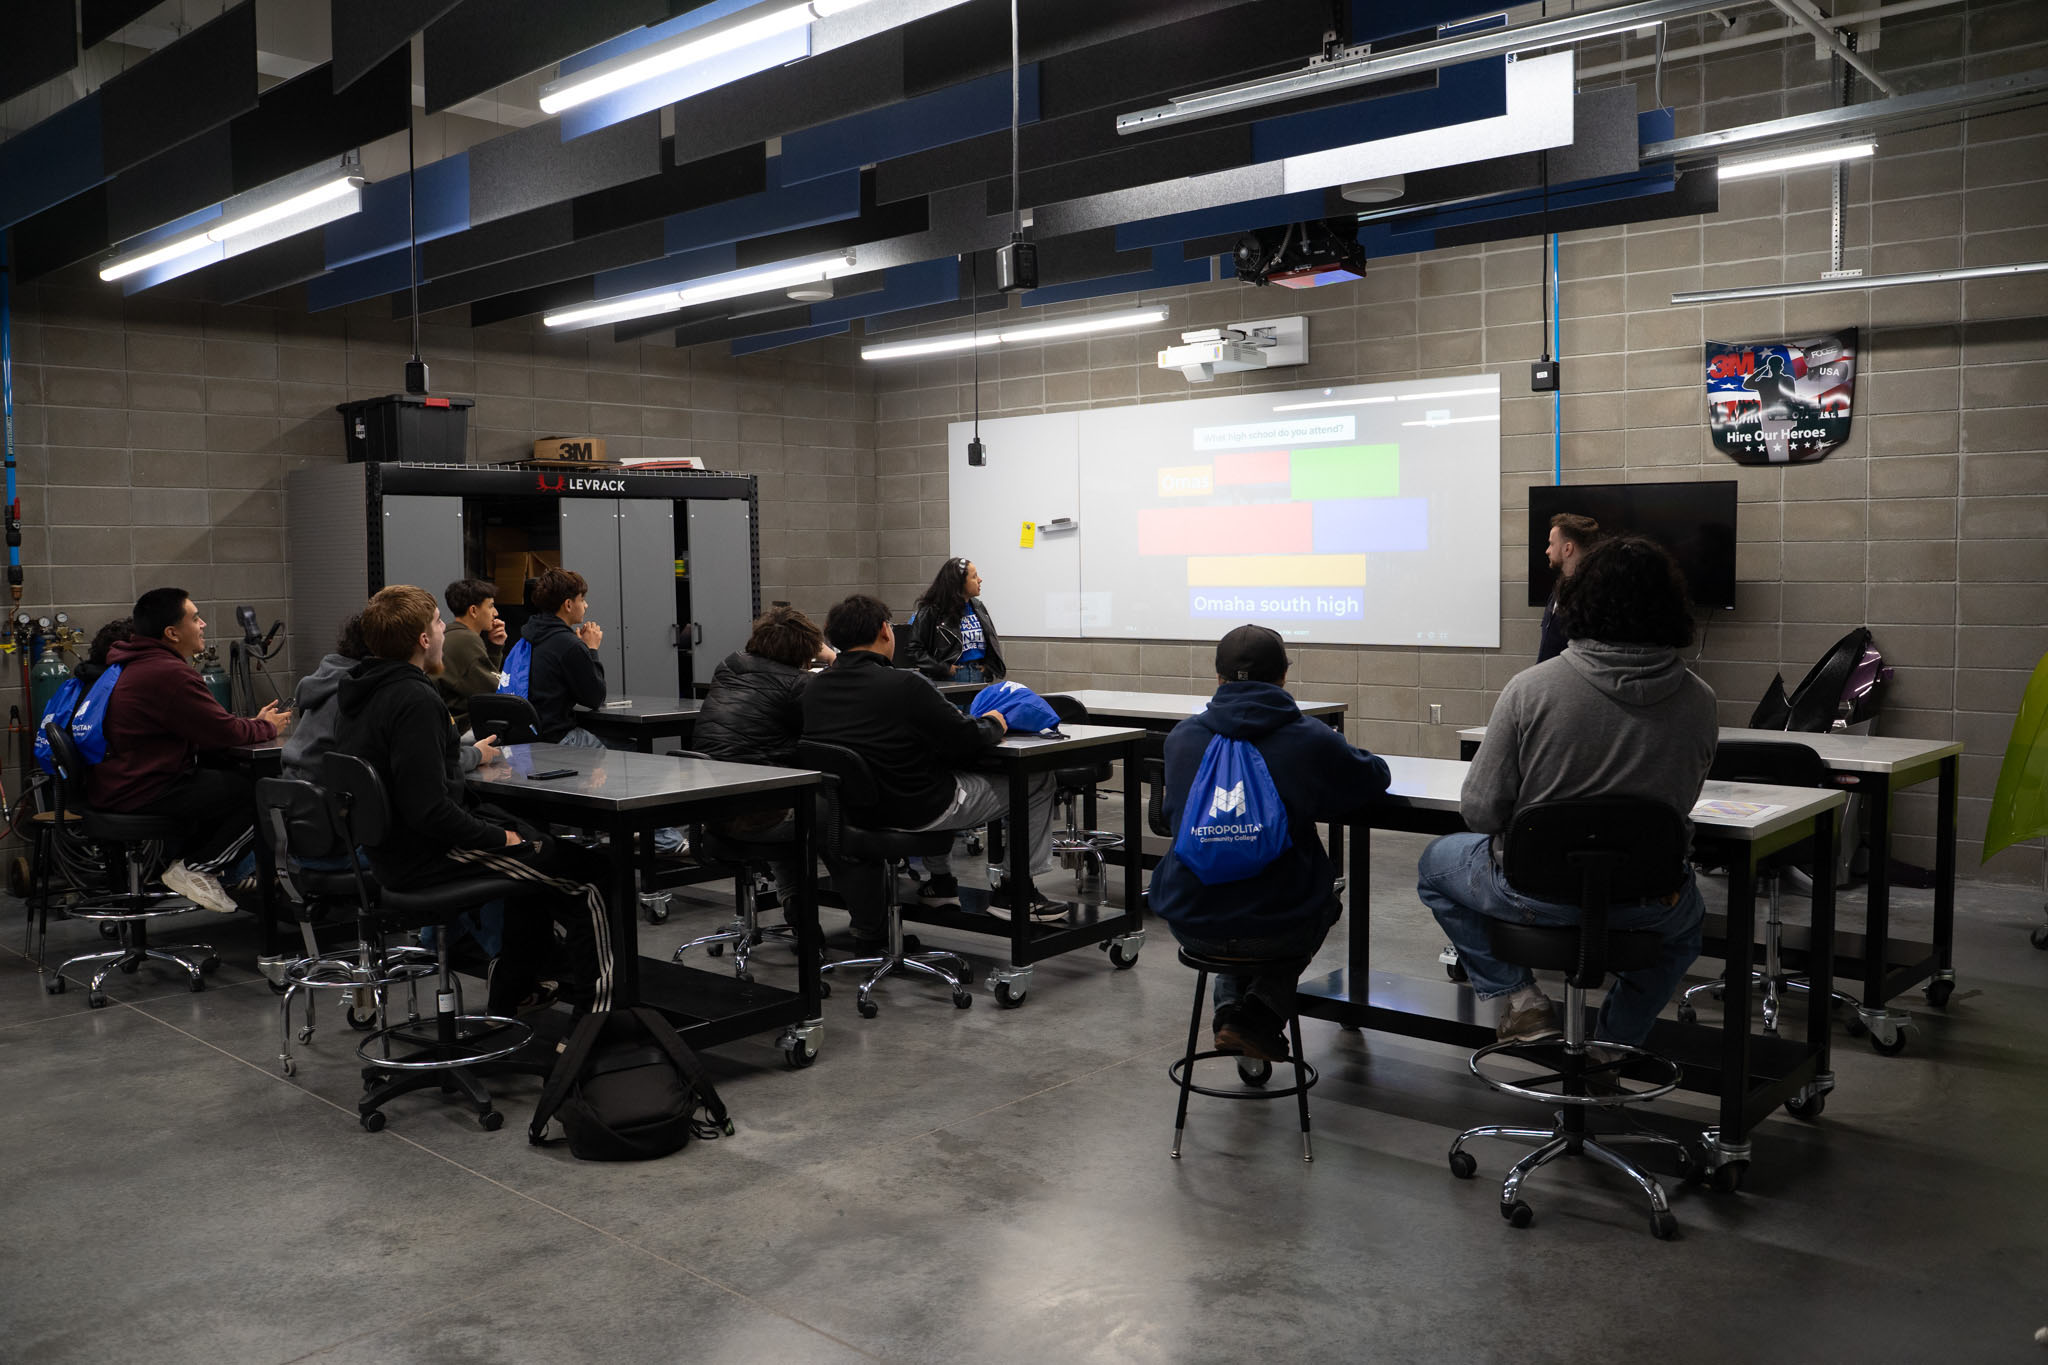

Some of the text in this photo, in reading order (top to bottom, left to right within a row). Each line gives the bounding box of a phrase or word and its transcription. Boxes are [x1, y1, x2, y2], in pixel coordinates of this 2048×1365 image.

[1709, 352, 1755, 379] 3M
[1819, 367, 1840, 377] USA
[1228, 433, 1247, 444] high
[1248, 430, 1276, 441] school
[1277, 428, 1289, 438] do
[1290, 428, 1308, 440] you
[1308, 424, 1345, 436] attend?
[1727, 428, 1826, 443] Hire Our Heroes
[559, 443, 593, 461] 3M
[569, 479, 625, 492] LEVRACK
[1194, 596, 1359, 616] Omaha south high
[1234, 834, 1257, 842] College
